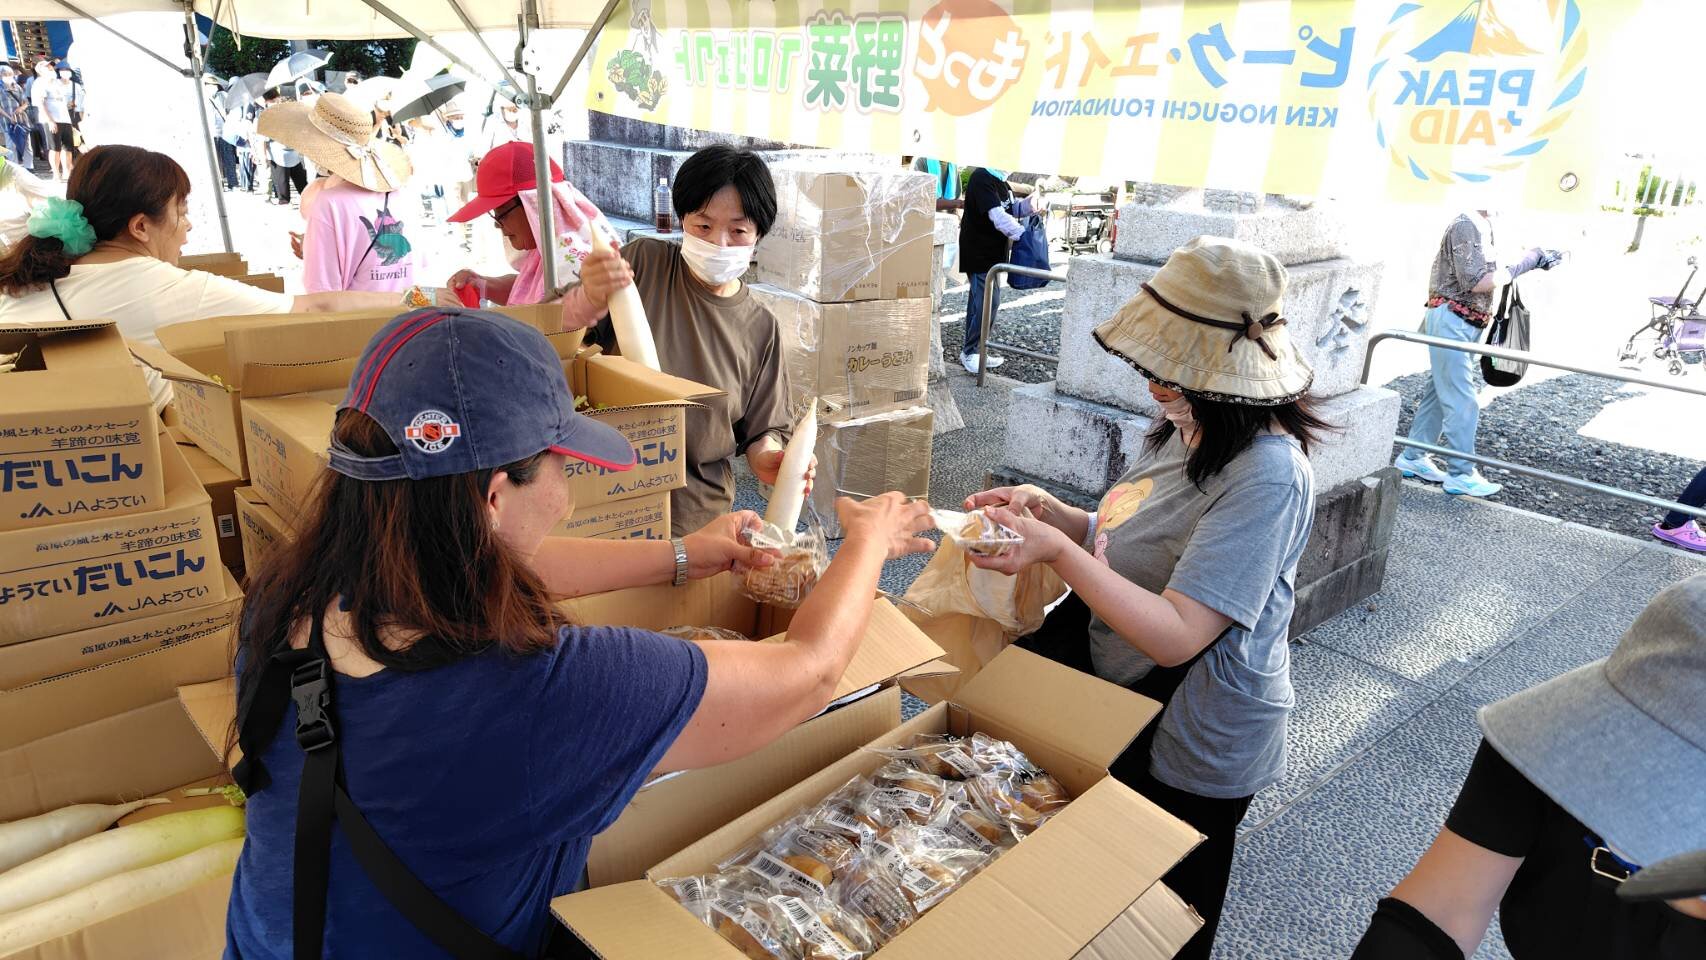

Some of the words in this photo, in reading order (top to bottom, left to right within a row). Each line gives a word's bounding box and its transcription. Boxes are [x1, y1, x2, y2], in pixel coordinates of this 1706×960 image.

[847, 349, 914, 374] カレーうどん
[51, 432, 140, 448] 羊蹄の味覚
[0, 453, 143, 492] だいこん
[36, 517, 200, 552] 高原の風と水と心のメッセージ
[121, 528, 202, 551] 羊蹄の味覚
